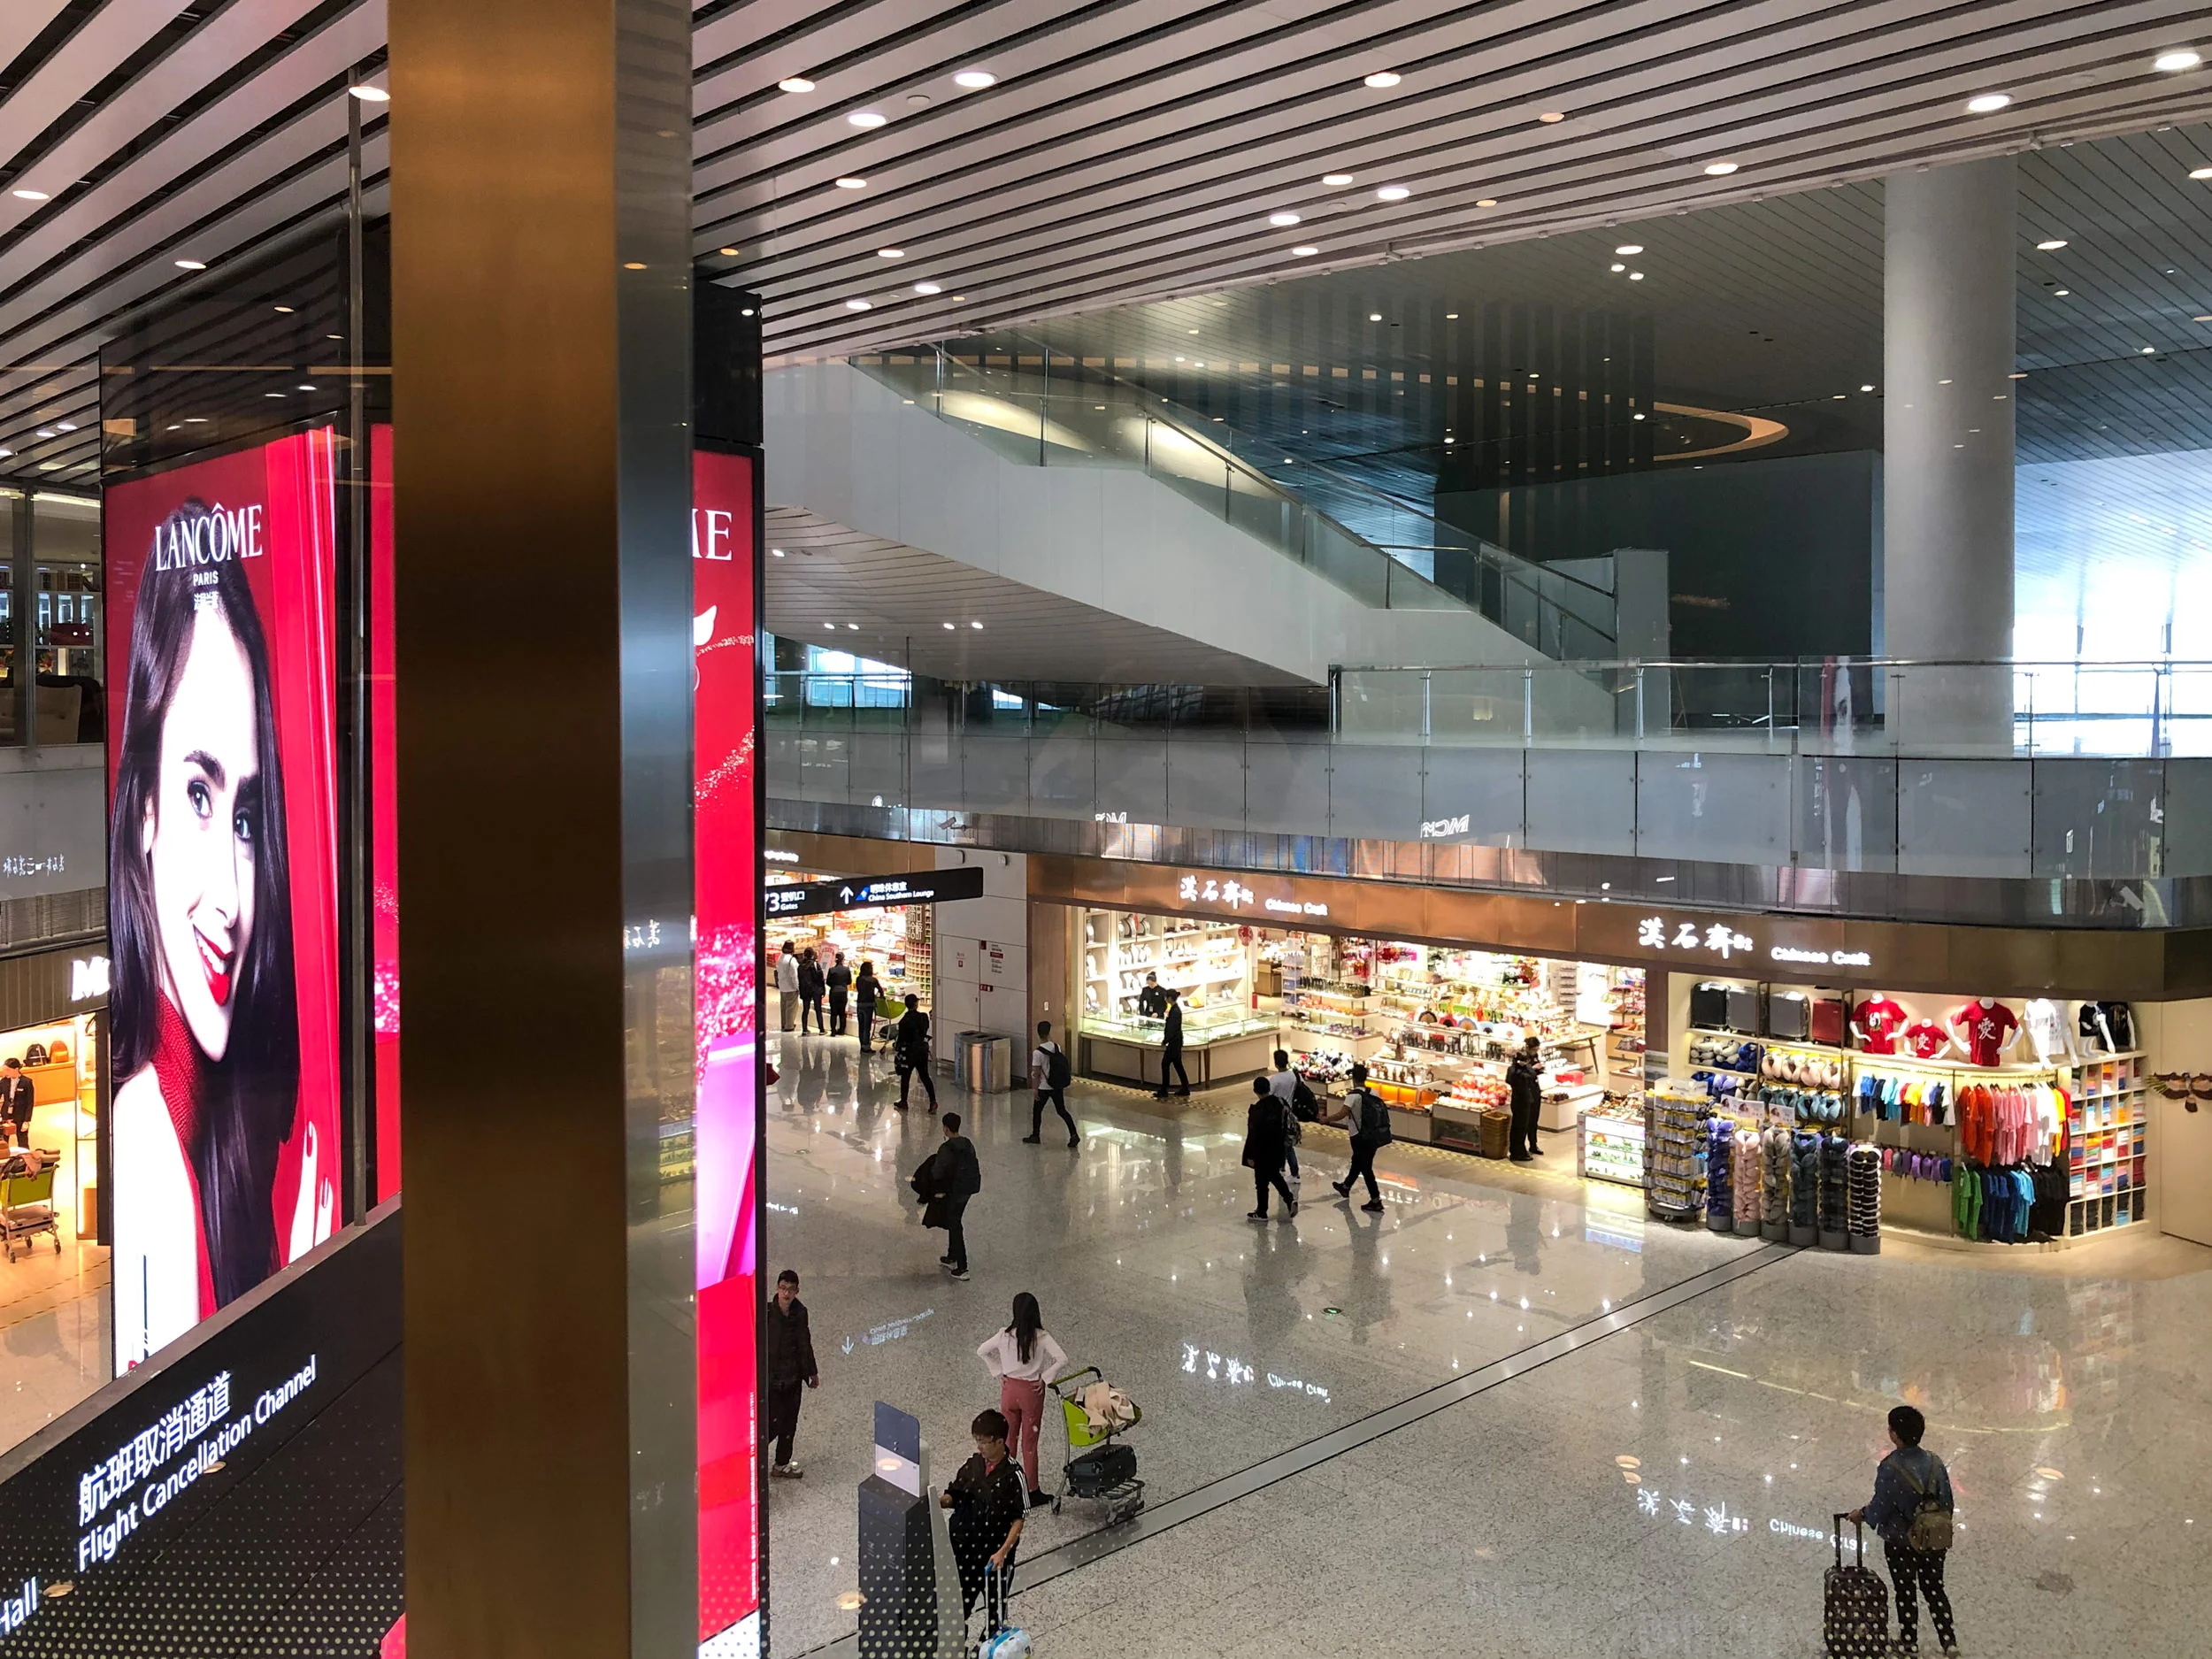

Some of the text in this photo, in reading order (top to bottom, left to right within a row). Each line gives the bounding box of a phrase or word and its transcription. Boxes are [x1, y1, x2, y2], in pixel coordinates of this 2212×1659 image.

[155, 502, 263, 572] LANCÔME
[193, 571, 219, 587] PARIS
[868, 894, 886, 902] China
[886, 892, 912, 901] Southern
[79, 1371, 231, 1527] 航班取消通道
[79, 1354, 316, 1572] Flight Cancellation Channel
